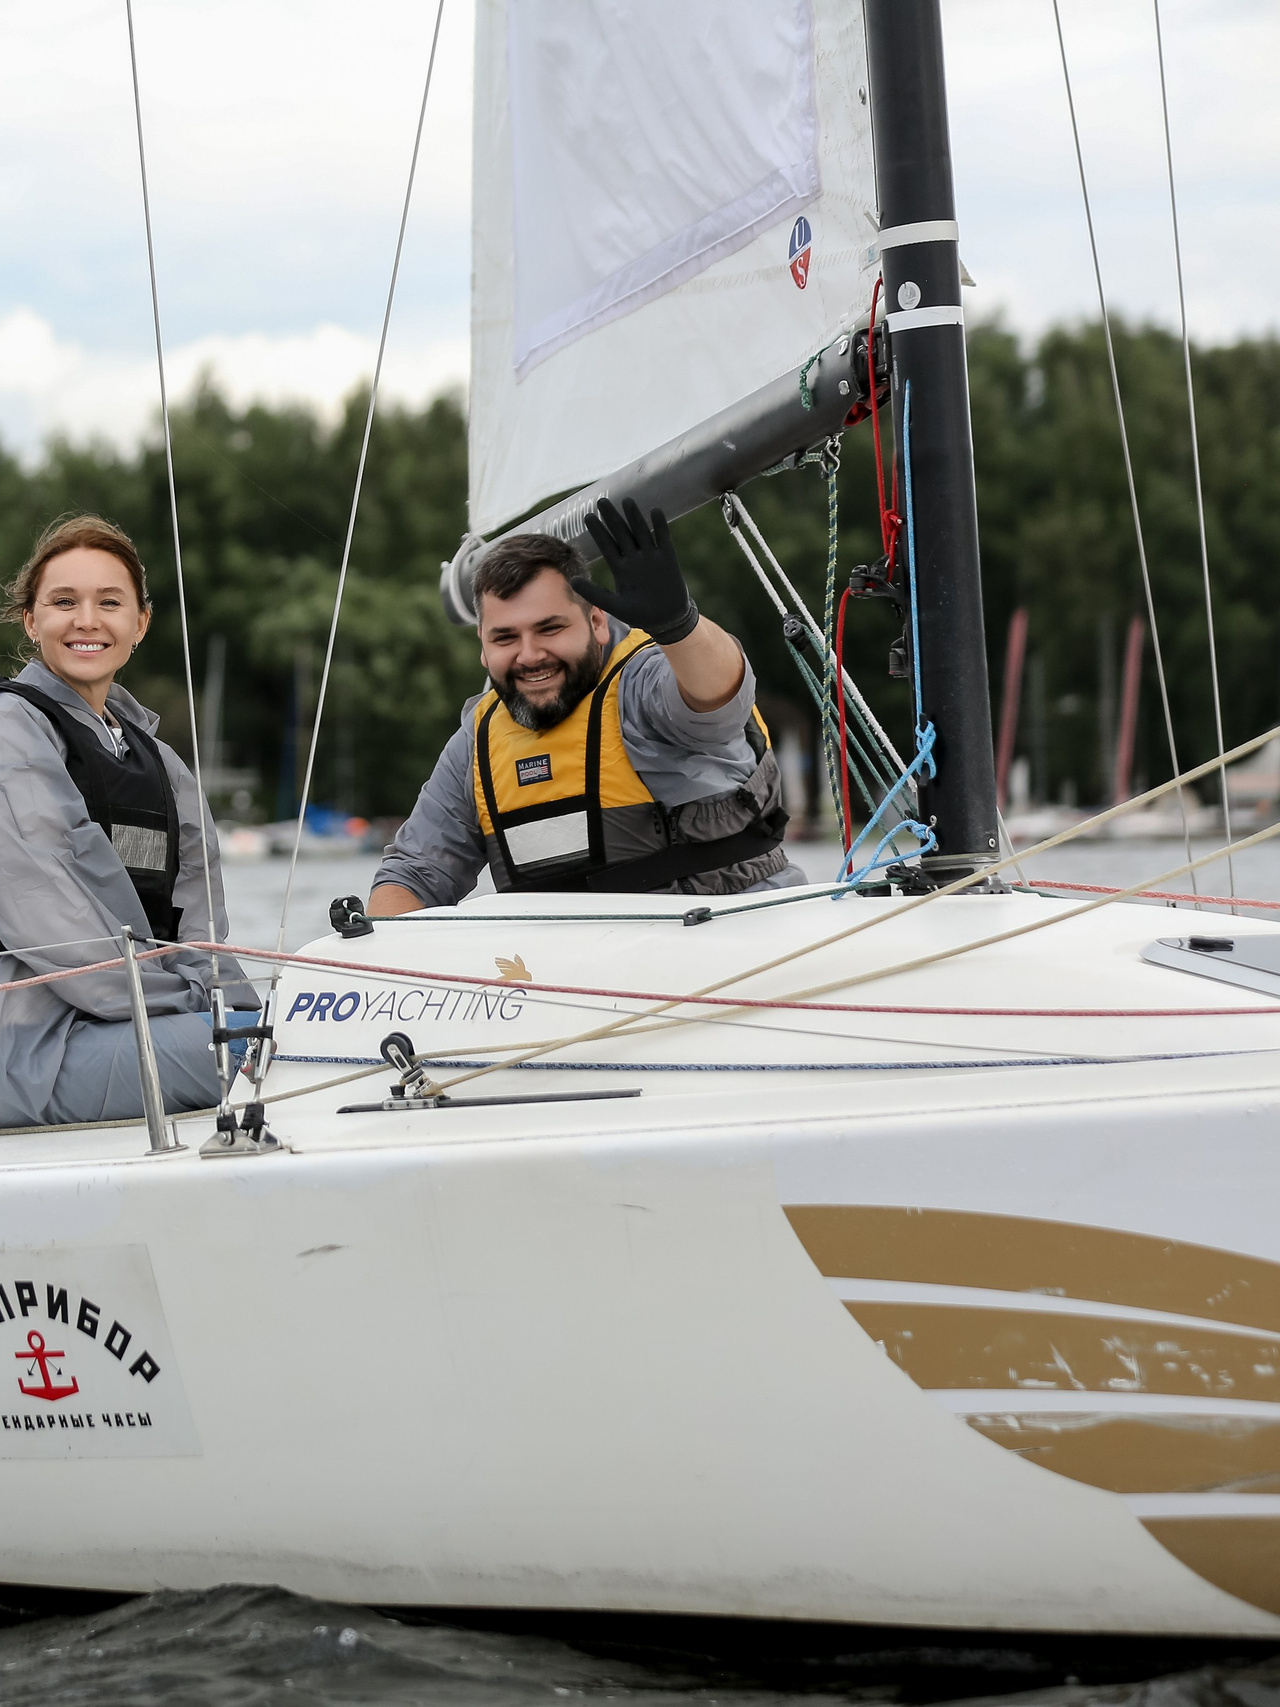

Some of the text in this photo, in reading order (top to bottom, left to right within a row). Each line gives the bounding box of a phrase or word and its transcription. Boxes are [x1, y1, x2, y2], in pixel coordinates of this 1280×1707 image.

[518, 759, 547, 769] MARINE
[284, 989, 528, 1022] PROYACHTING
[102, 1412, 153, 1429] ЧАСЫ
